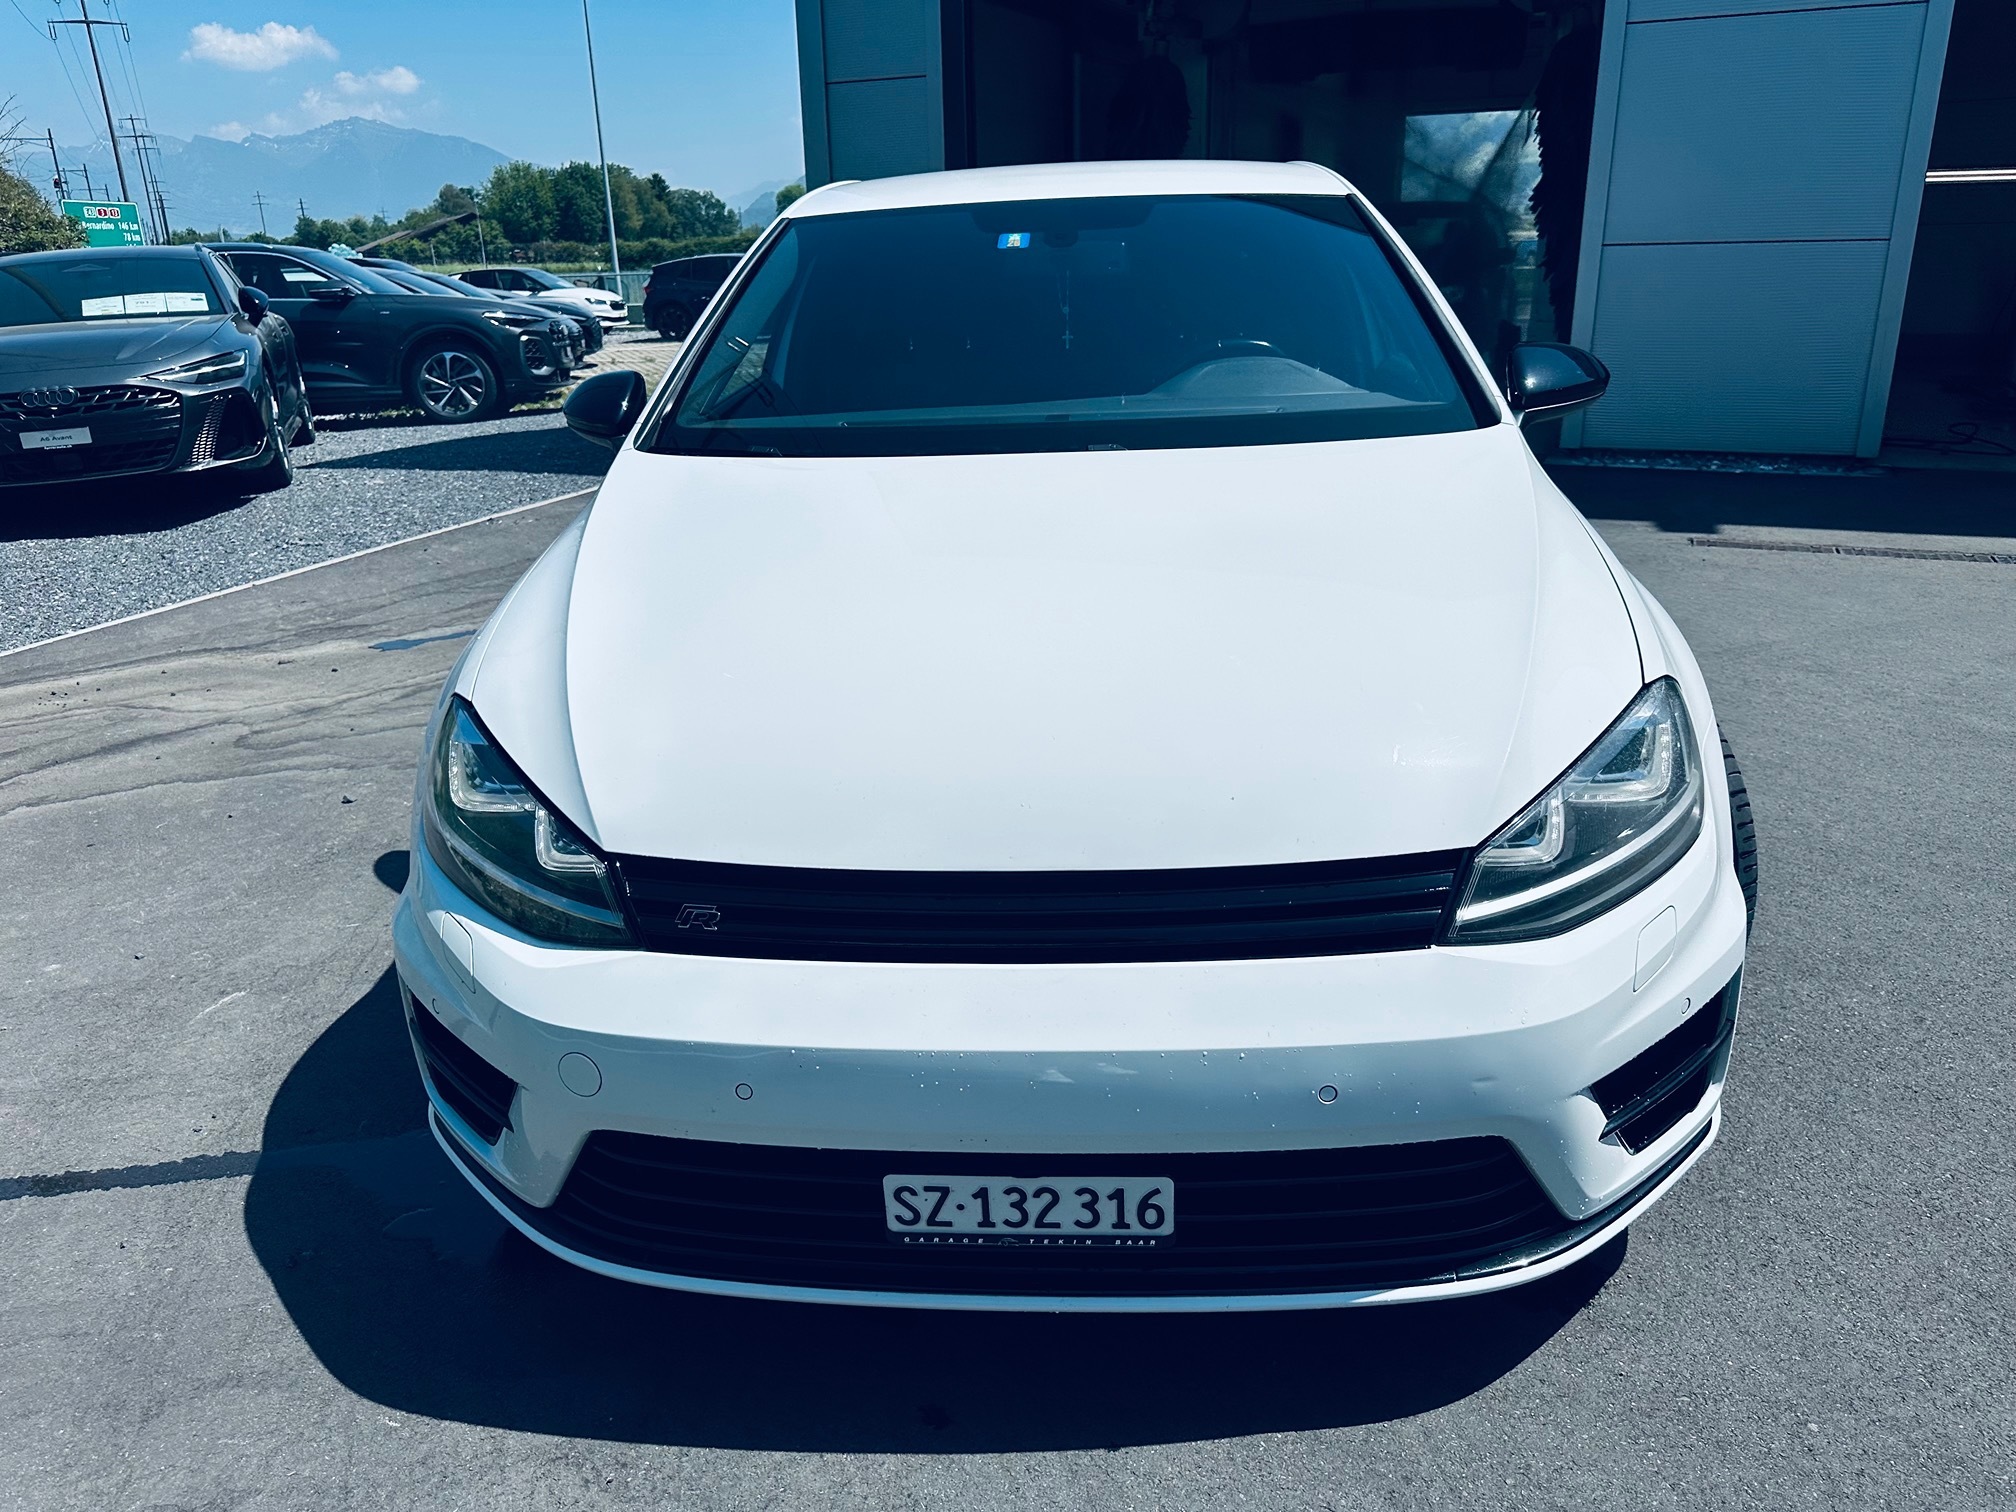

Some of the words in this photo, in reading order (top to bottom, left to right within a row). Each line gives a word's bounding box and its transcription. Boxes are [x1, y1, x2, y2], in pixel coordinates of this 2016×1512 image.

[129, 222, 139, 230] km
[131, 233, 141, 241] km
[903, 1236, 985, 1244] GARAGE
